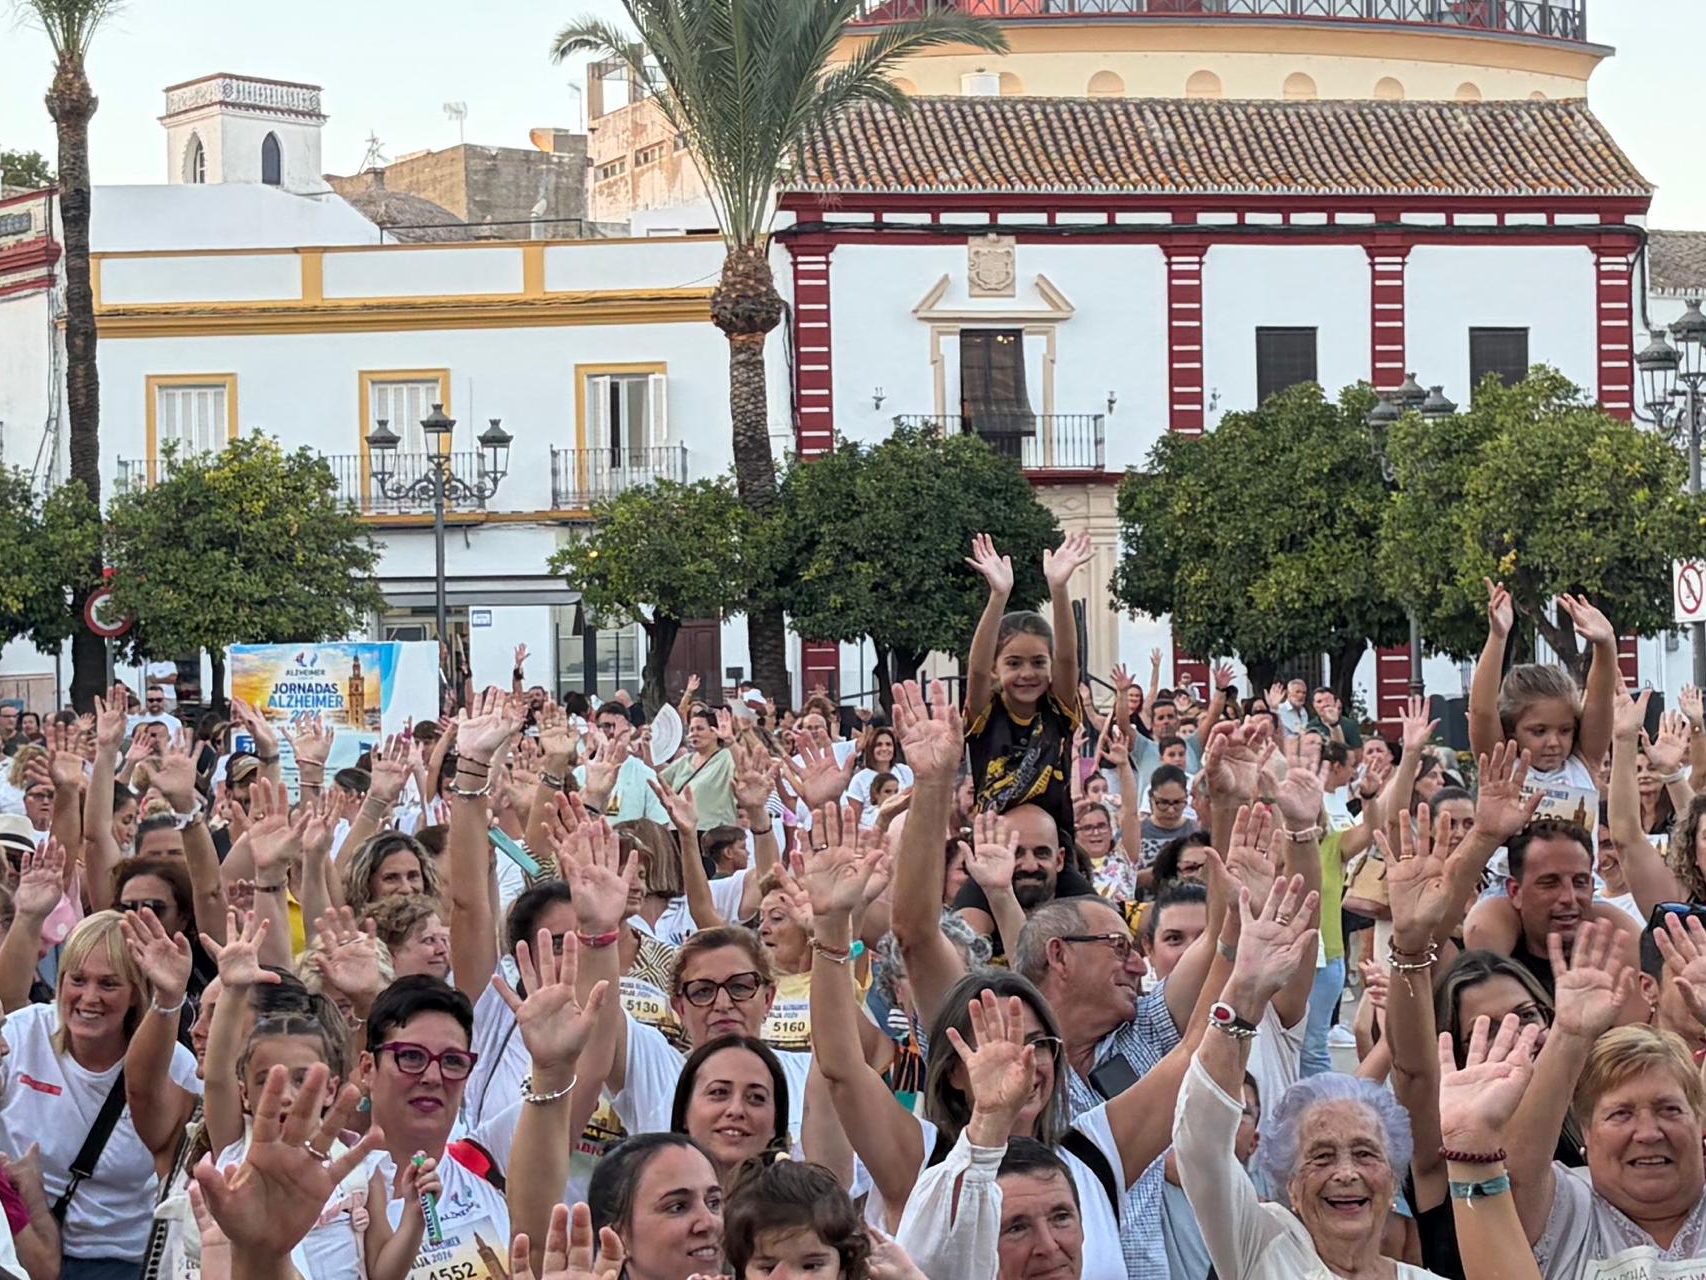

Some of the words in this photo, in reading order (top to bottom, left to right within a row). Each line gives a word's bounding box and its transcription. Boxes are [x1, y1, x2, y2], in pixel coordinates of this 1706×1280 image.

[285, 668, 326, 677] ALZHEIMER
[272, 682, 339, 695] JORNADAS
[267, 694, 345, 709] ALZHEIMER
[626, 1000, 659, 1014] 5130
[773, 1021, 805, 1033] 5160
